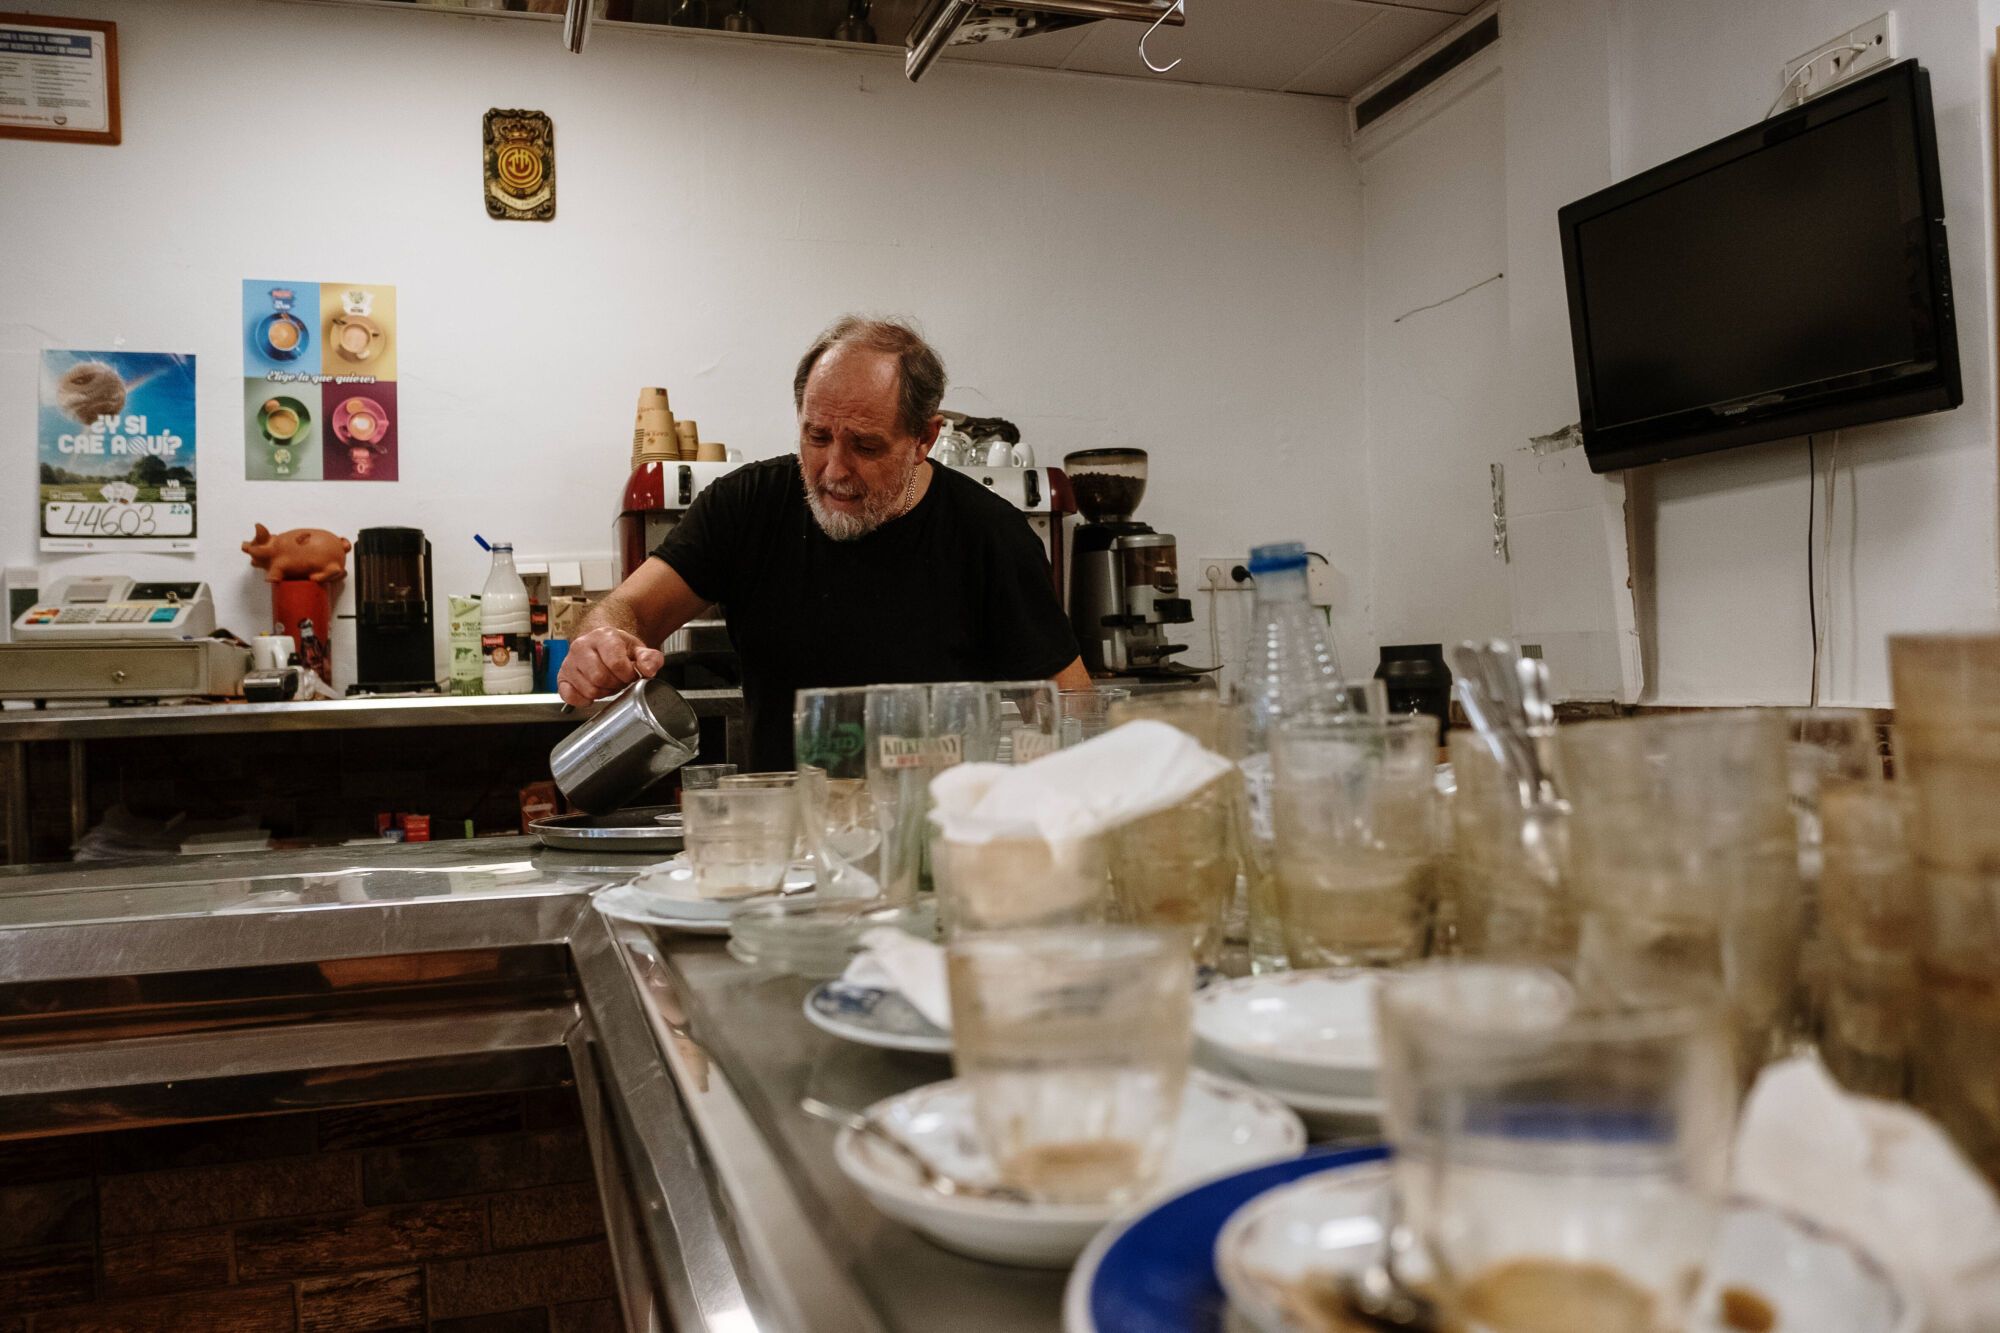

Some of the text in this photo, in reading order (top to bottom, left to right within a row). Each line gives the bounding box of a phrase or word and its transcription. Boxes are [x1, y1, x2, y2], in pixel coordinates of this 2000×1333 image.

[266, 371, 376, 385] Elige la que quieres
[91, 414, 147, 435] ¿Y SI
[58, 429, 182, 456] CAE AQUÍ?
[64, 503, 157, 536] 44603
